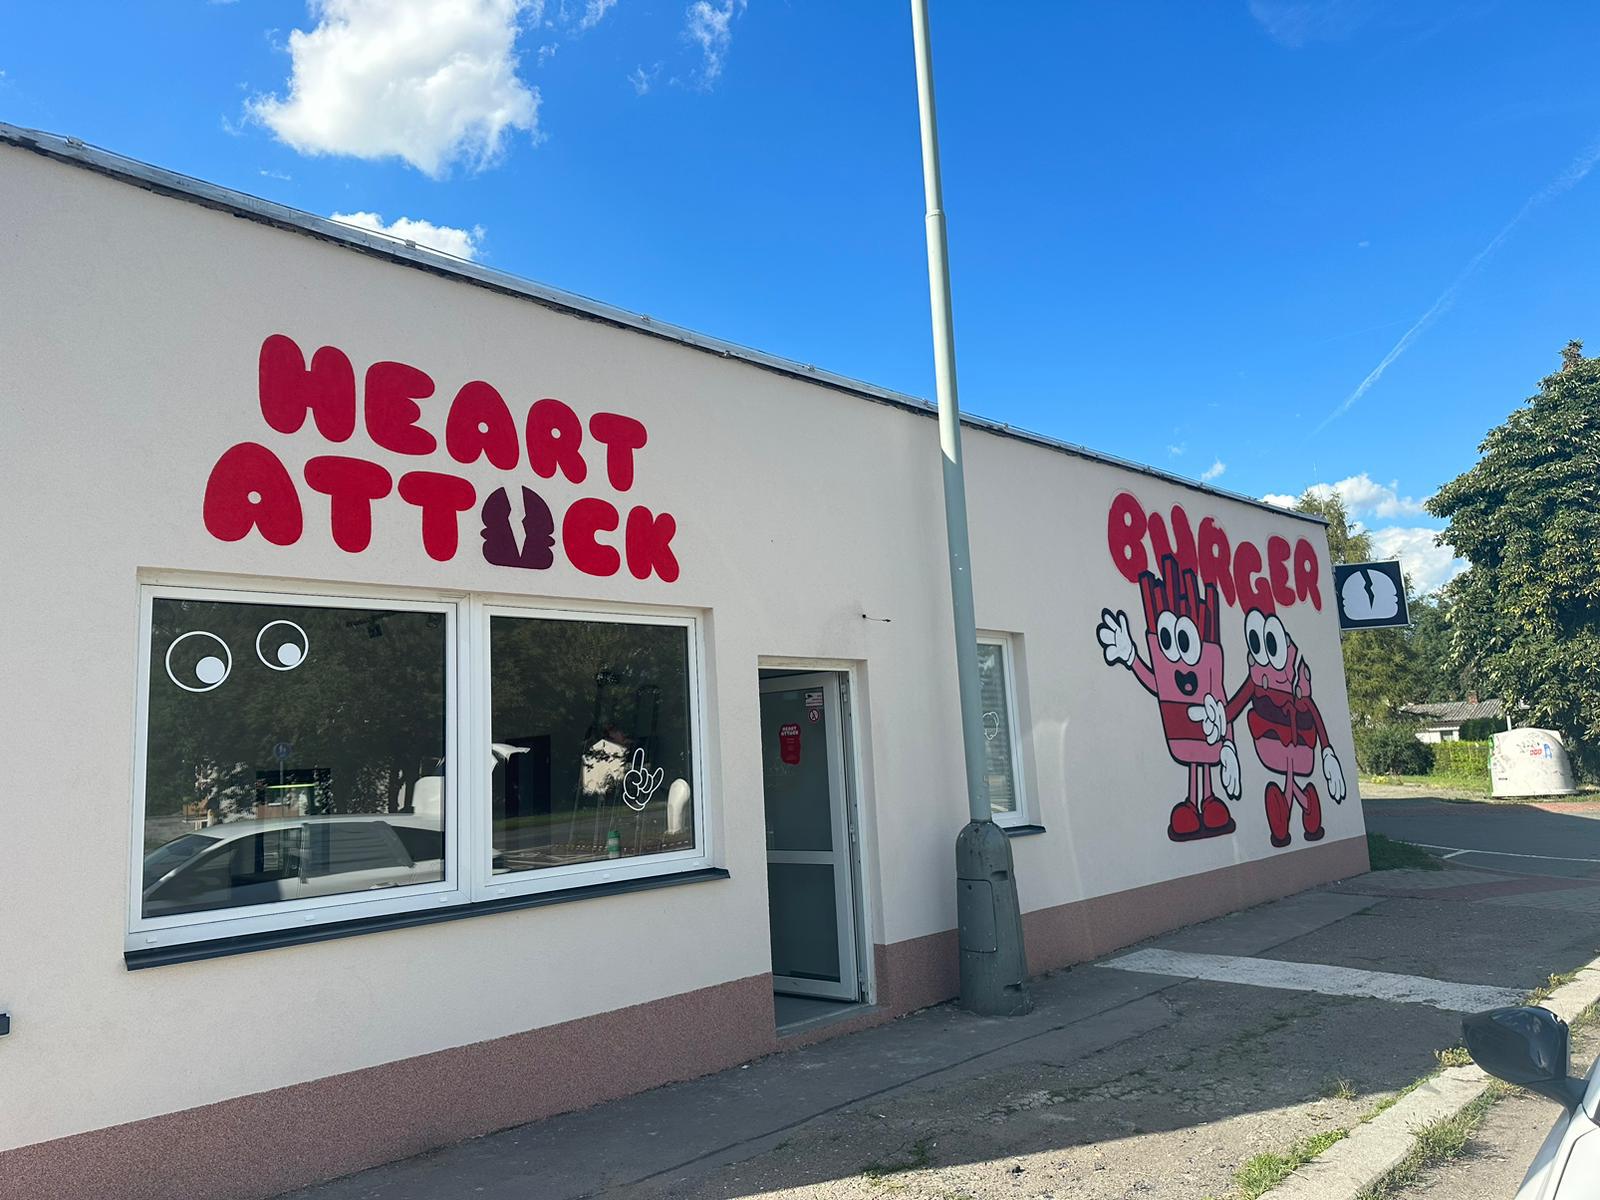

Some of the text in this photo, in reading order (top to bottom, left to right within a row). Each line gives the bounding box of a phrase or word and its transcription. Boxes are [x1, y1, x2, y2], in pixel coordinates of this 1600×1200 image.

[259, 335, 647, 491] HEART
[204, 442, 679, 583] ATTCK
[1108, 493, 1322, 615] BURGER
